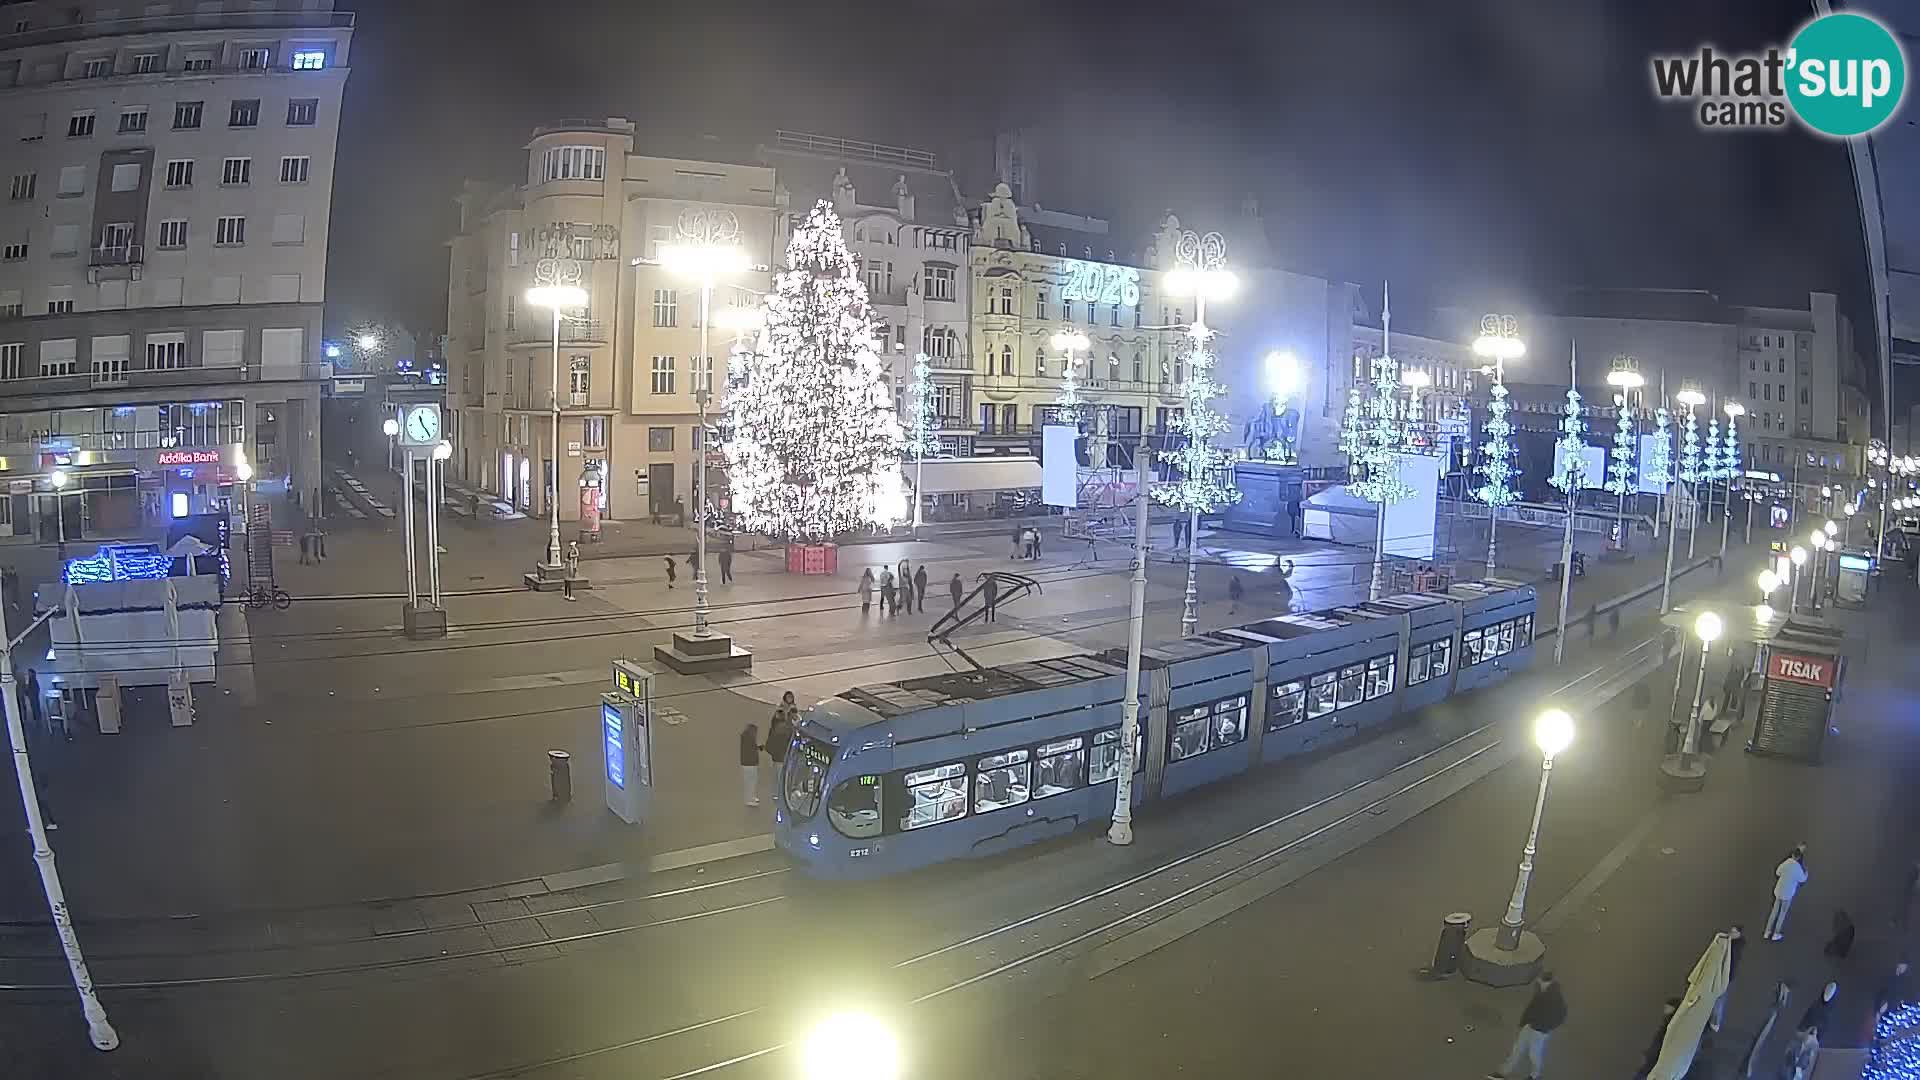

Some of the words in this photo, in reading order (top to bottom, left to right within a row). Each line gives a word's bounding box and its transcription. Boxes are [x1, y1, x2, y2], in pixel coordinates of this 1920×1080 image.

[1061, 261, 1140, 307] 2026
[193, 451, 219, 463] Bank
[1780, 659, 1822, 681] TISAK
